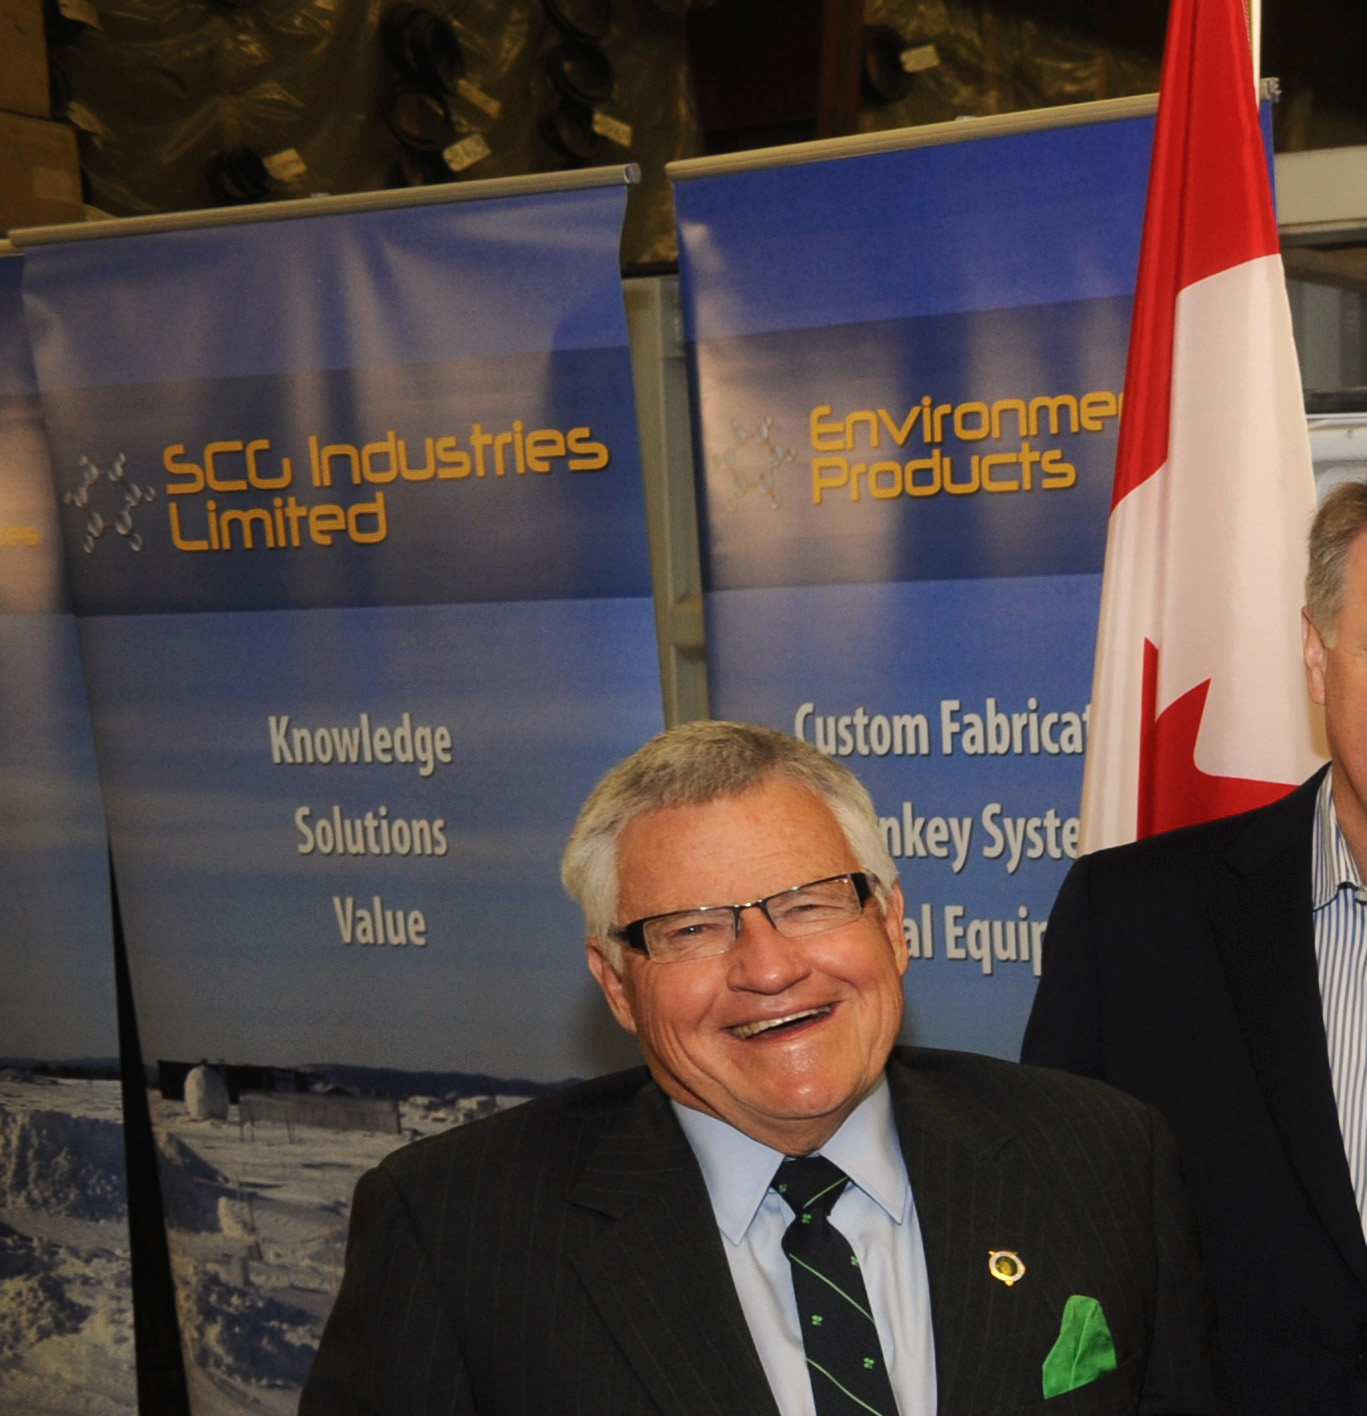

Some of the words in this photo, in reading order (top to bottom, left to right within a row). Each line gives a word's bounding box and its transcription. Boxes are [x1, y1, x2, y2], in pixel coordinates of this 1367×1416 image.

[809, 390, 1124, 452] Environme
[162, 439, 292, 495] SCG
[308, 420, 609, 488] Industries
[811, 442, 1077, 504] Products
[168, 491, 389, 552] Limited
[268, 712, 452, 777] Knowledge
[794, 701, 929, 756] Custom
[294, 804, 448, 856] Solutions
[333, 896, 427, 946] Value
